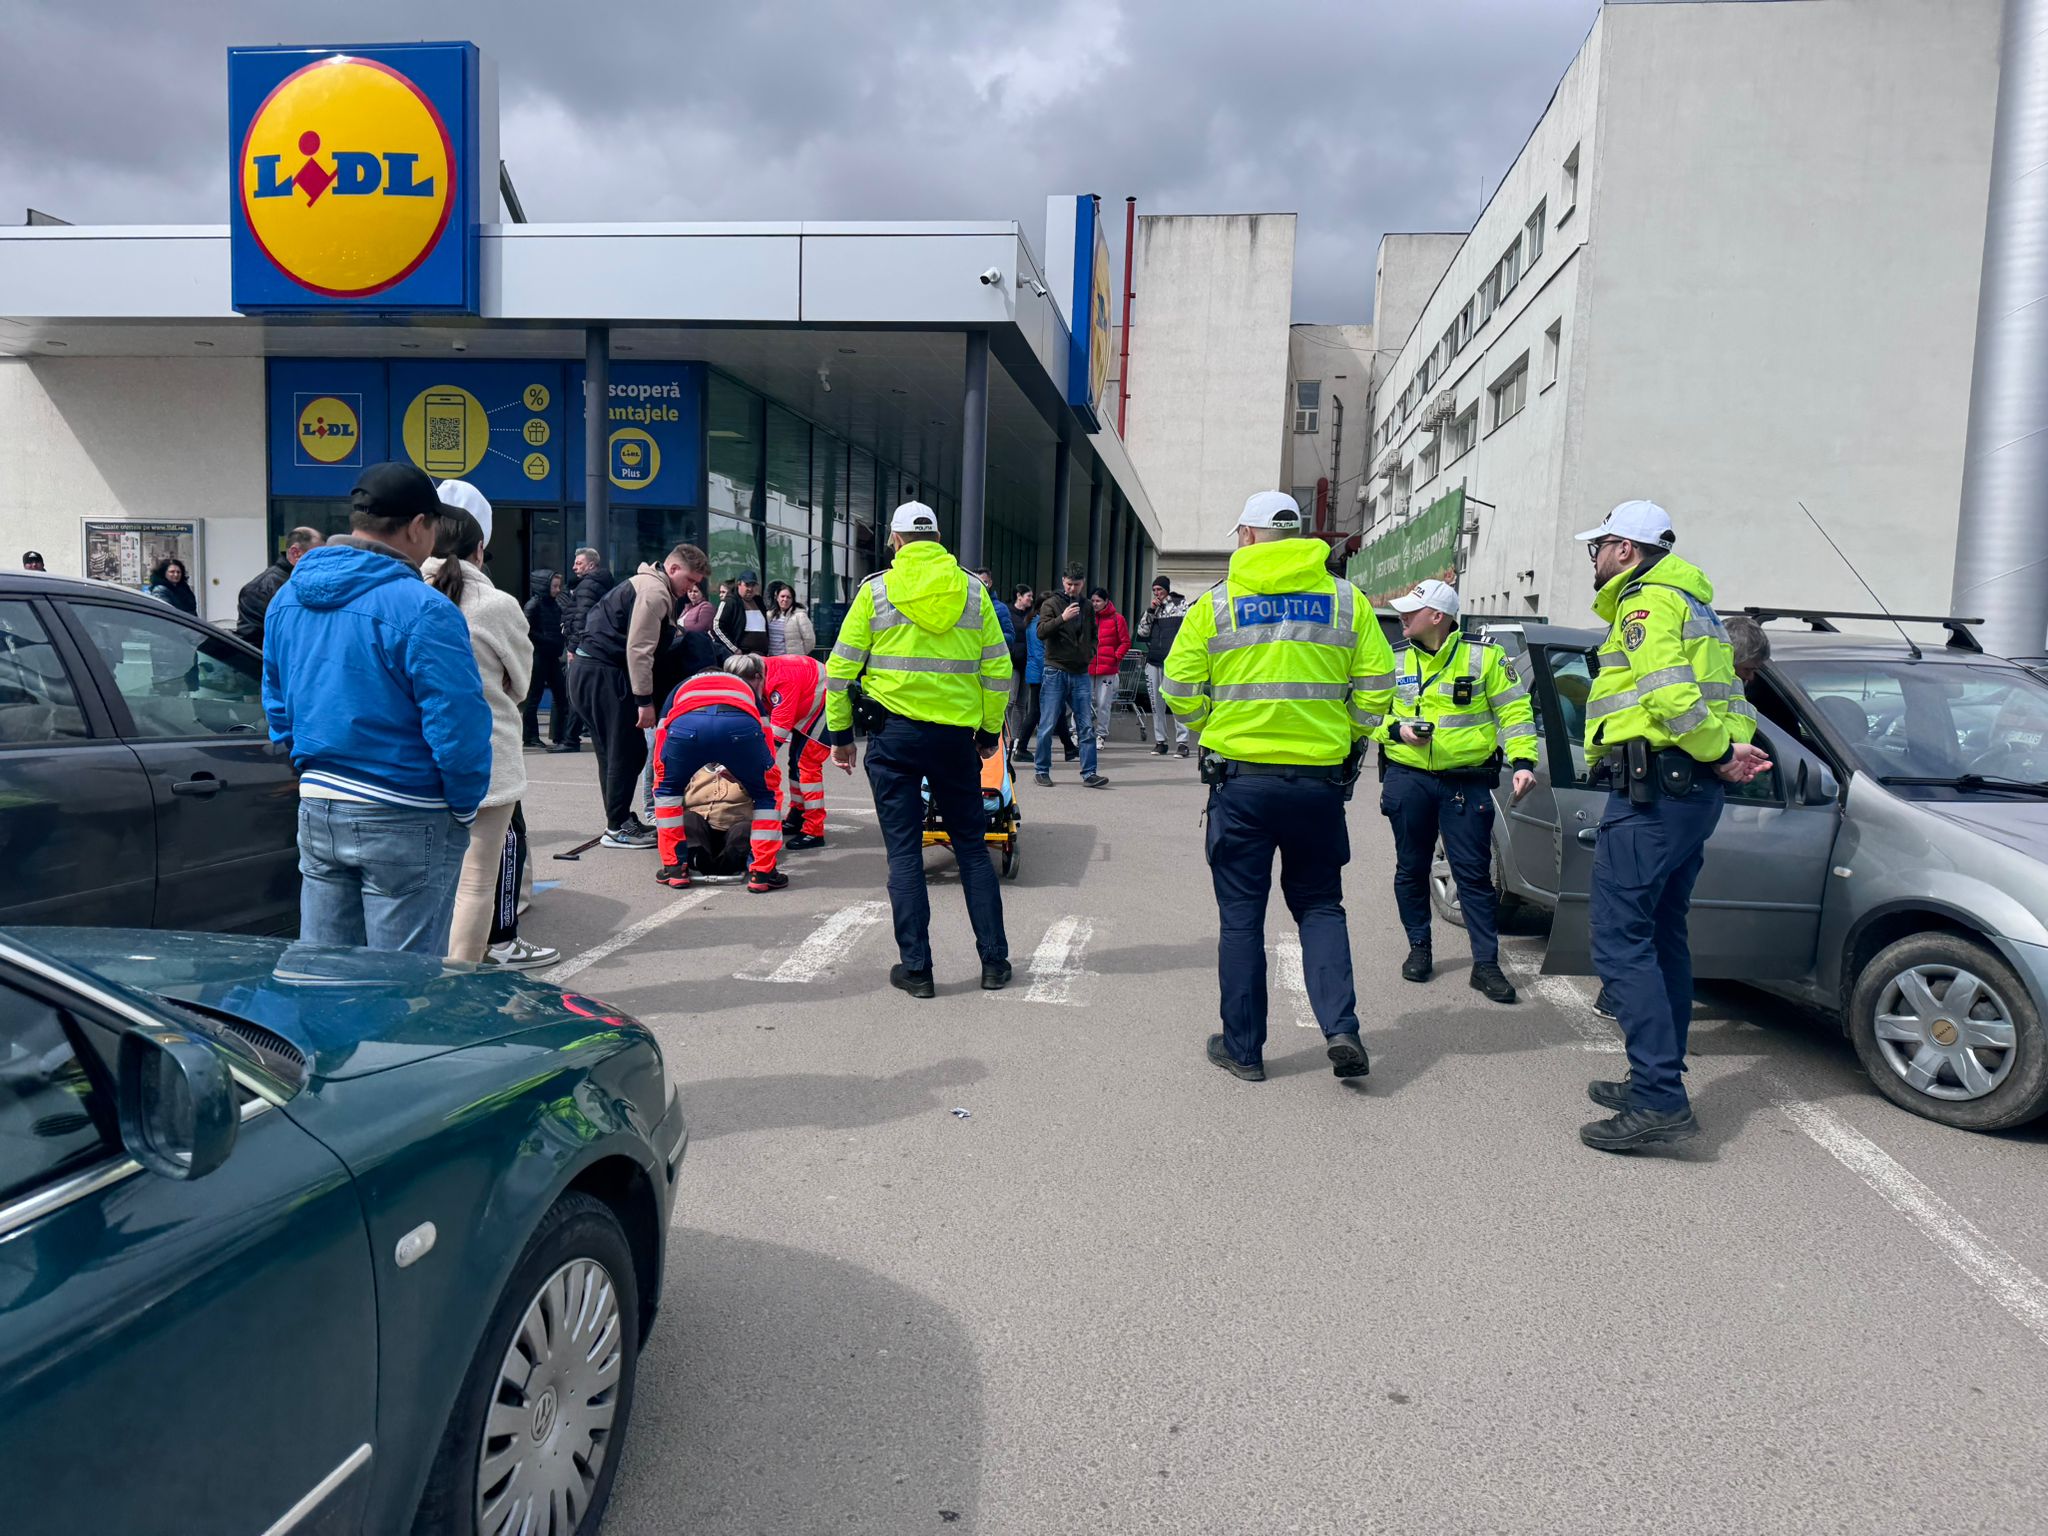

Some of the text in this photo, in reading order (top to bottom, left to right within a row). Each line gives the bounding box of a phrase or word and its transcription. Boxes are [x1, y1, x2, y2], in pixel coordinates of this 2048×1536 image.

[582, 380, 681, 401] scoperă
[622, 468, 641, 478] Plus
[1243, 598, 1324, 619] POLITIA
